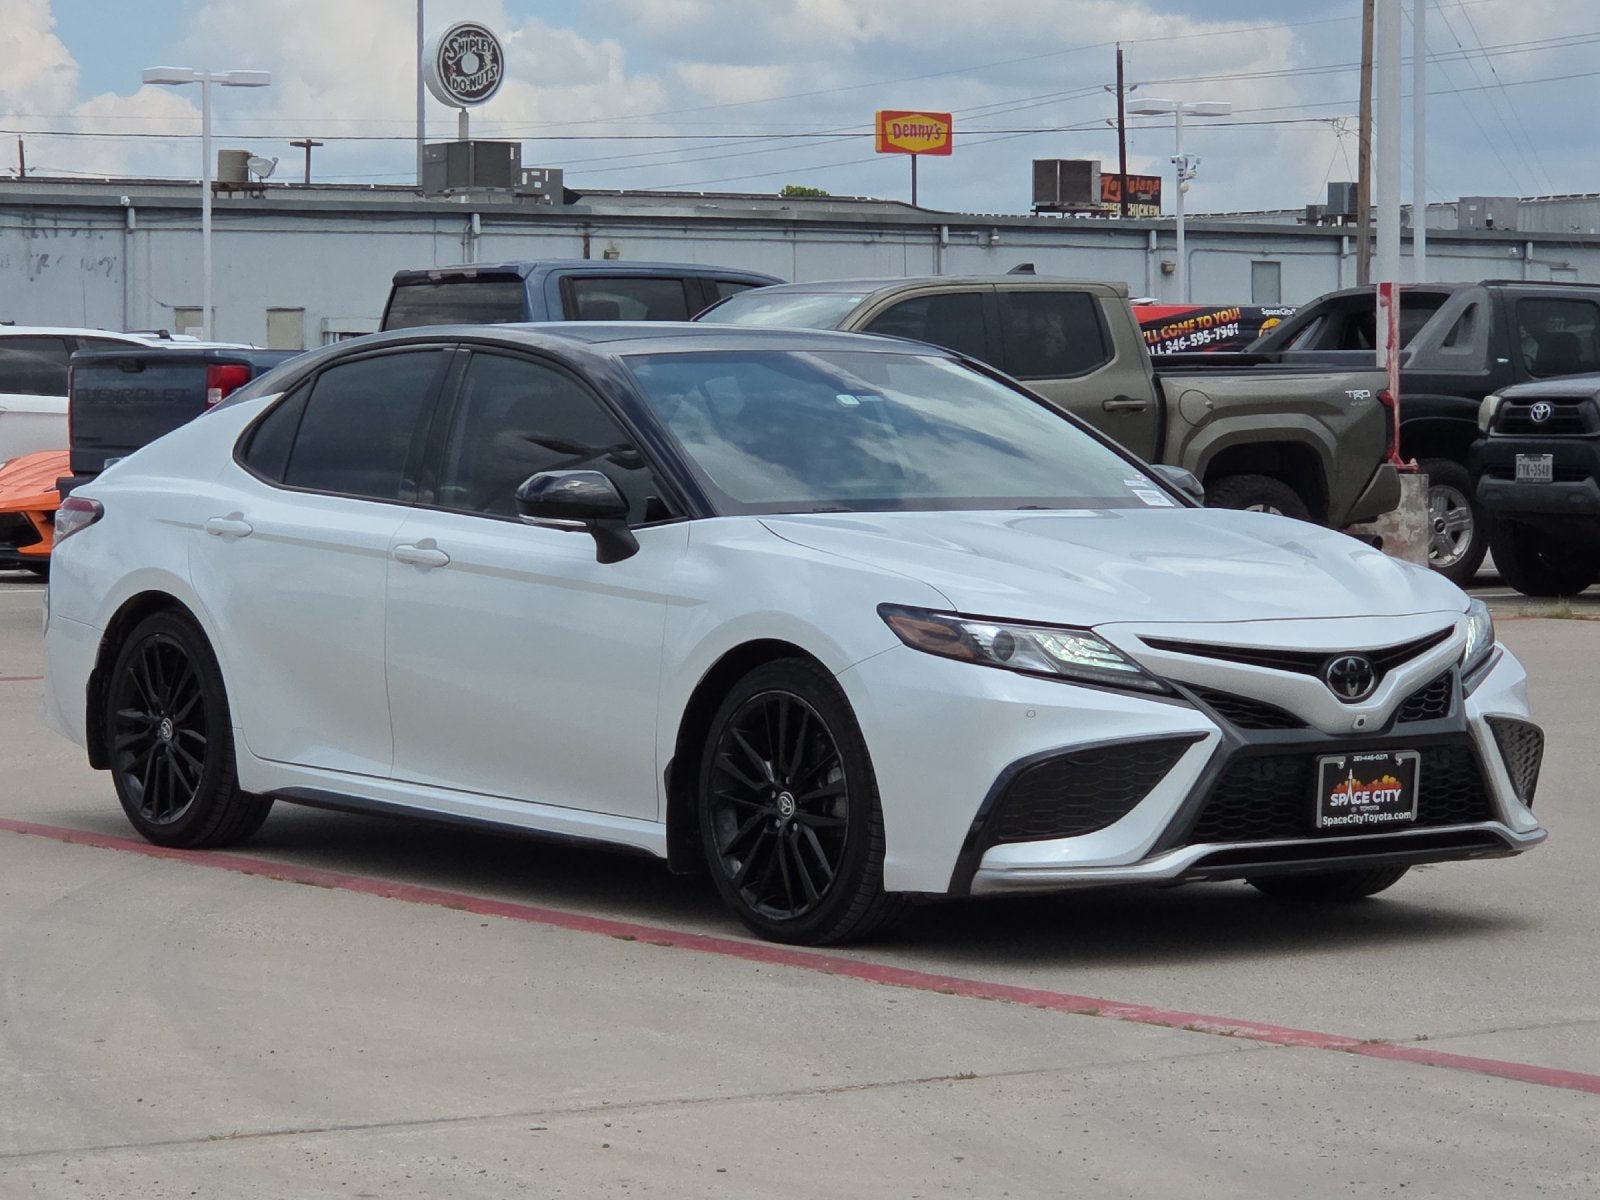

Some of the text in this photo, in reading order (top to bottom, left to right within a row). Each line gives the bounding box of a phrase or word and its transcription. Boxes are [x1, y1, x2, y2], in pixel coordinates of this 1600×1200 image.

[444, 37, 494, 61] SHIPLEY
[452, 65, 497, 91] DO-NUTS
[892, 123, 942, 141] Denny's
[1161, 319, 1195, 339] COME
[1196, 315, 1214, 328] TO
[1214, 307, 1242, 324] YOU!
[1345, 390, 1370, 400] TRD
[1330, 789, 1402, 806] SPACE CITY
[1322, 811, 1412, 826] SpaceCityToyota.com
